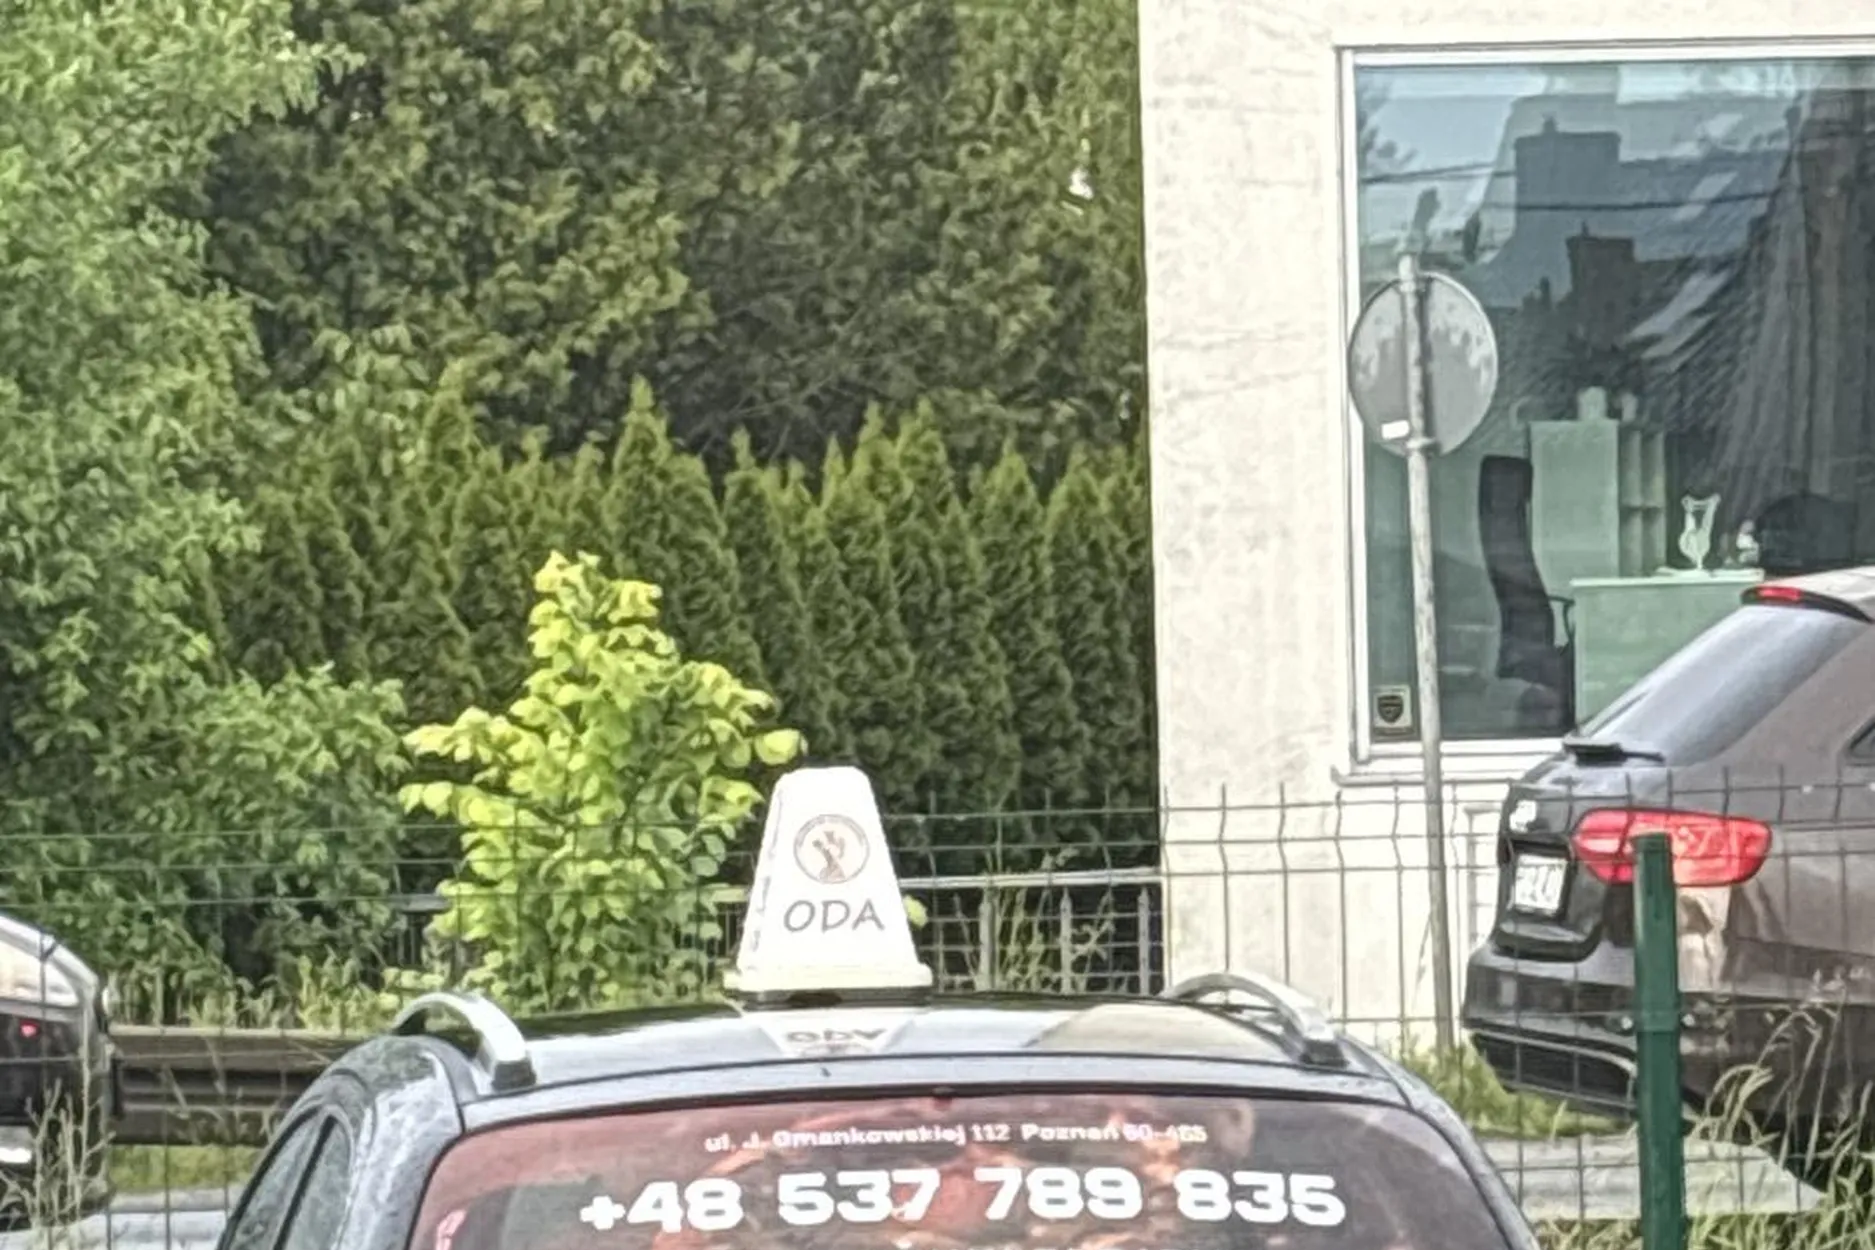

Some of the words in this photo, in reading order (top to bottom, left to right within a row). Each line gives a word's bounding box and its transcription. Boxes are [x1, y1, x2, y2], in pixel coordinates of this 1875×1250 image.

[783, 899, 886, 933] ODA
[971, 1124, 1010, 1142] 112
[579, 1177, 745, 1233] +48
[777, 1168, 941, 1225] 537
[974, 1167, 1143, 1221] 789
[1173, 1169, 1347, 1227] 835
